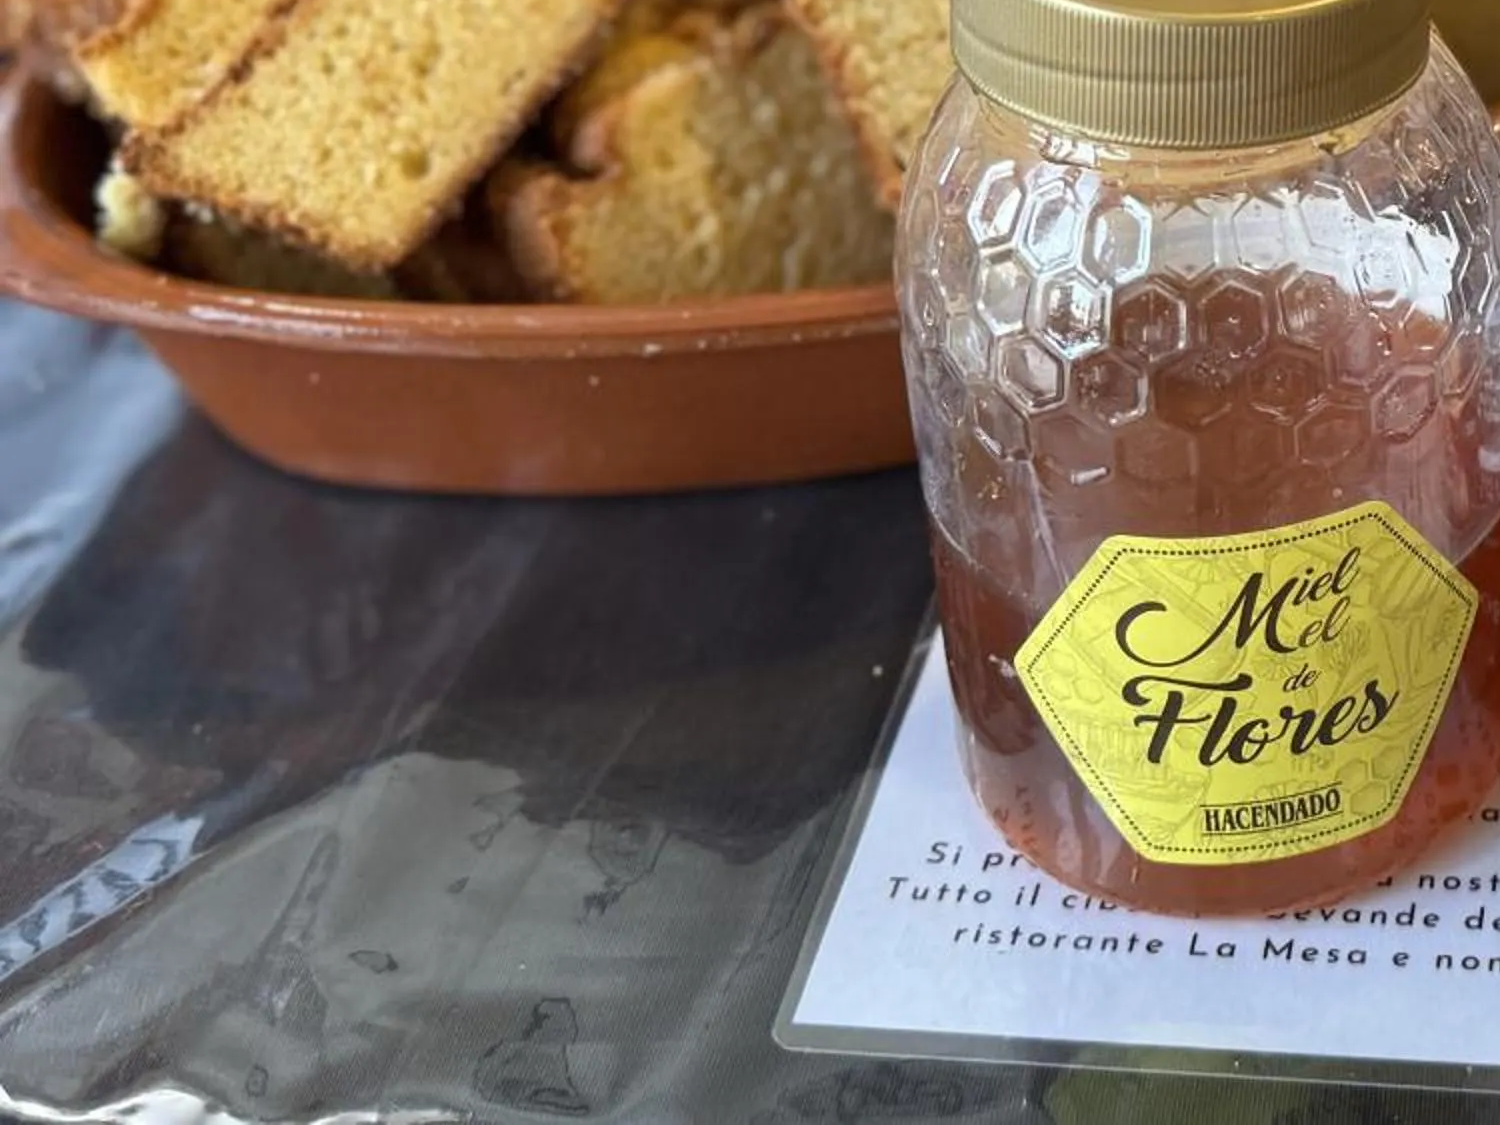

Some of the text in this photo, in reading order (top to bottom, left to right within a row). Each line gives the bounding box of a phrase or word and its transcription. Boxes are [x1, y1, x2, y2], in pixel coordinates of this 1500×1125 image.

[1115, 546, 1361, 668] Miel
[1283, 662, 1319, 693] de
[1122, 675, 1399, 767] Flores
[1203, 784, 1342, 833] HACENDADO
[925, 840, 963, 867] Si
[888, 876, 993, 905] Tutto
[1014, 882, 1042, 908] il
[952, 922, 1165, 955] ristorante
[1188, 931, 1237, 959] La
[1261, 937, 1368, 967] Mesa
[1391, 951, 1411, 969] e
